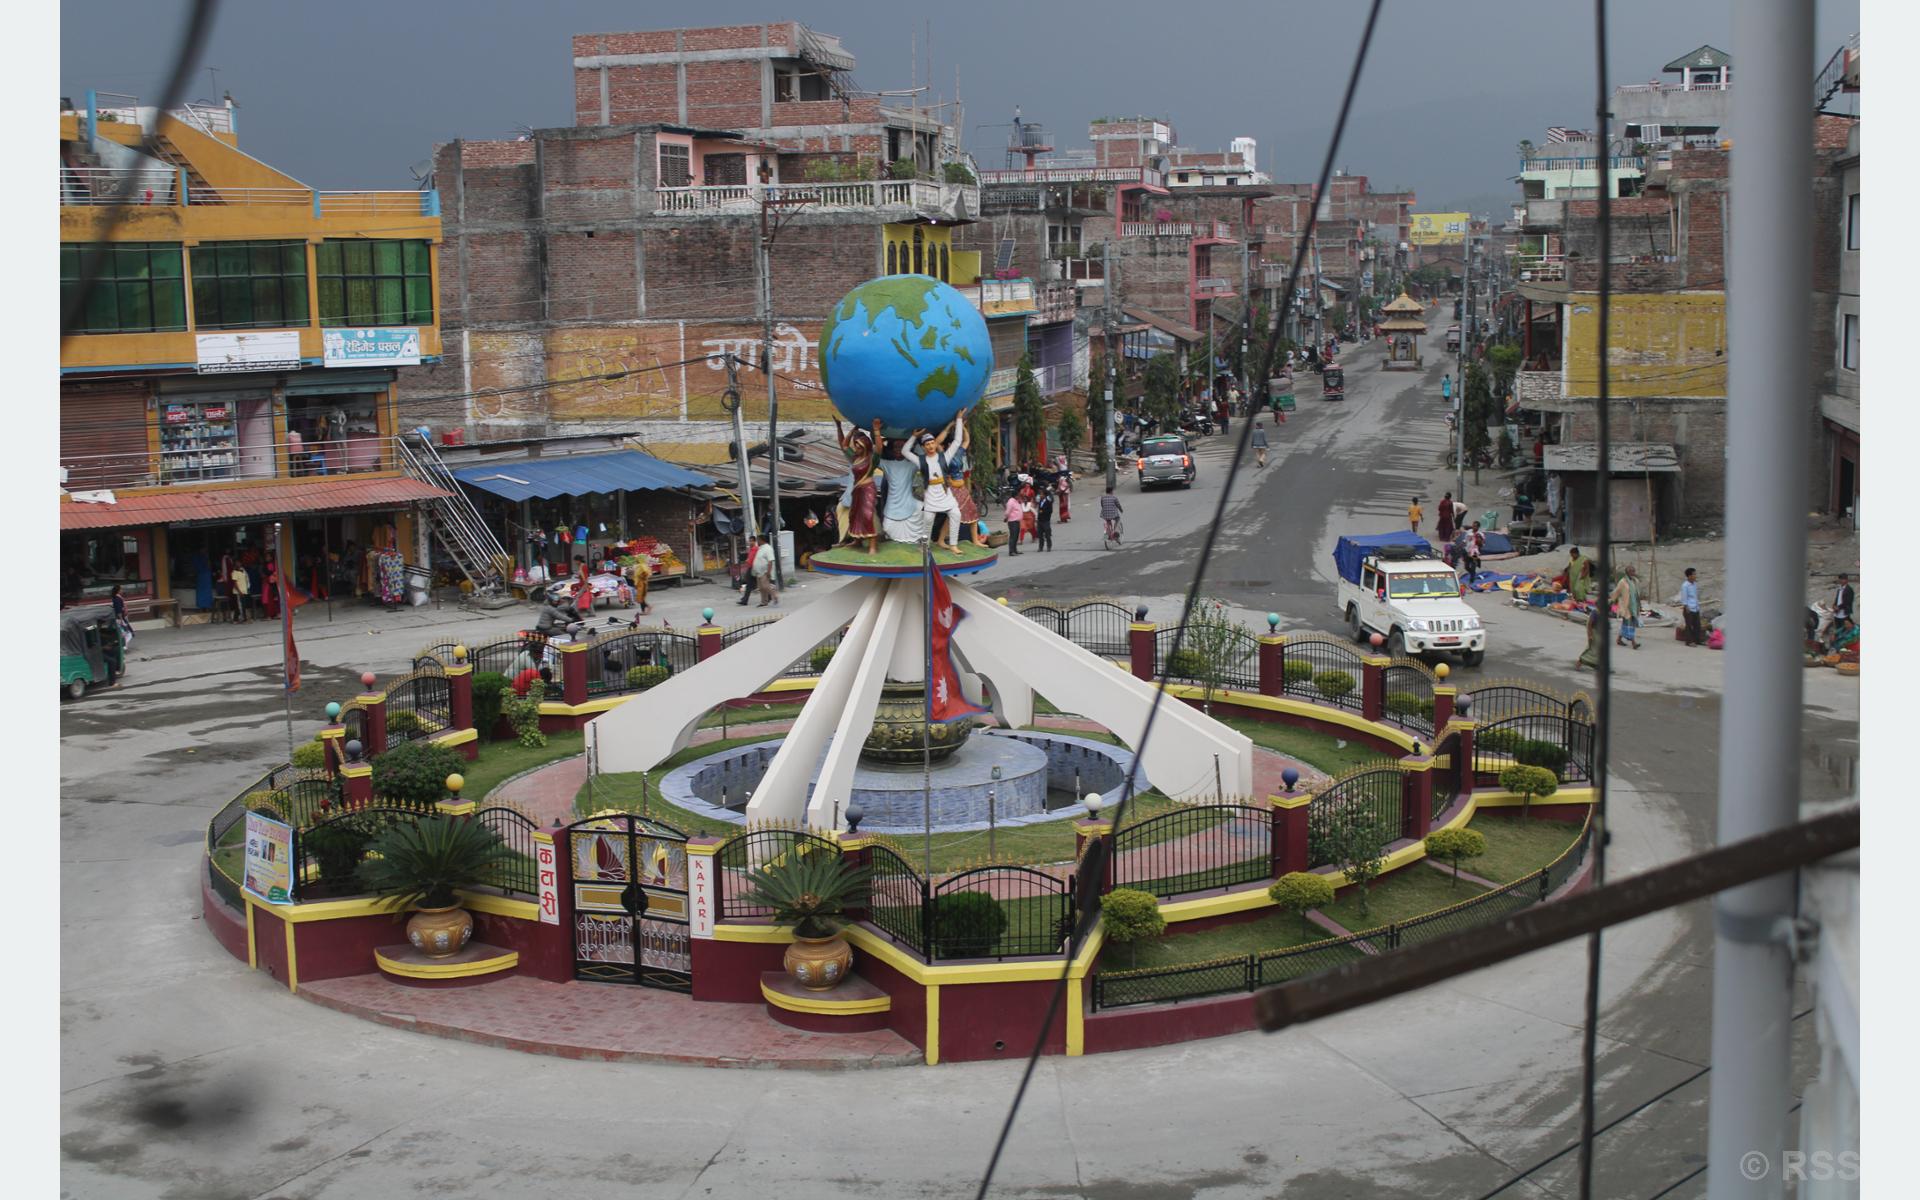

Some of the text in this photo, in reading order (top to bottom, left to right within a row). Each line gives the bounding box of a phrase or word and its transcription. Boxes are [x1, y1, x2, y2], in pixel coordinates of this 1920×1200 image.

[378, 341, 400, 352] पसल
[539, 847, 556, 916] कटारी
[695, 860, 707, 932] KATARI
